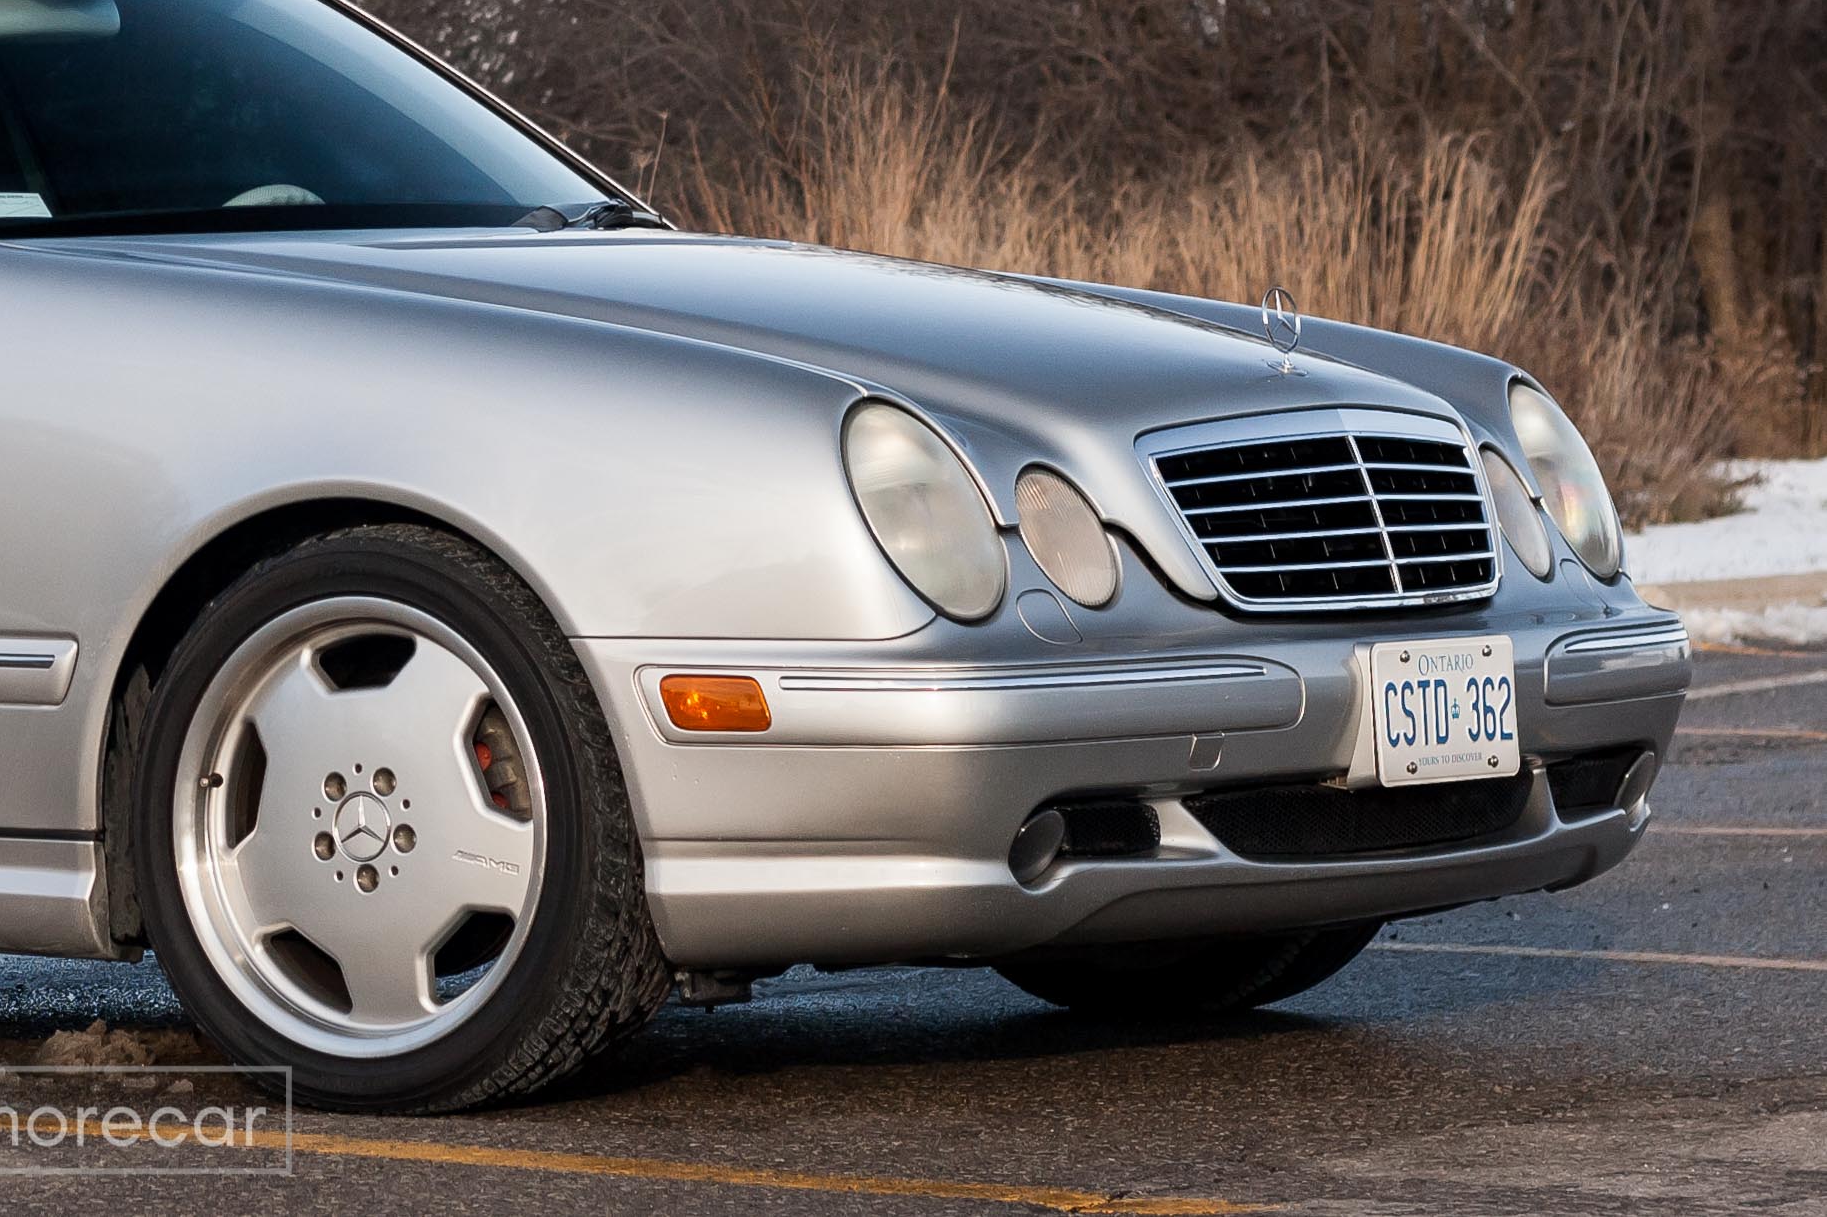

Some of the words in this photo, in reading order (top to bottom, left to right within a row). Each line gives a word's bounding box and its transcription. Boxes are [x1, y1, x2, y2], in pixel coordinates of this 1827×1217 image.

[1384, 679, 1450, 748] CSTD
[1466, 676, 1514, 742] 362
[1417, 756, 1440, 766] YOURS
[1441, 754, 1450, 764] TO
[1452, 752, 1483, 763] DISCOVER
[452, 849, 520, 875] AMG
